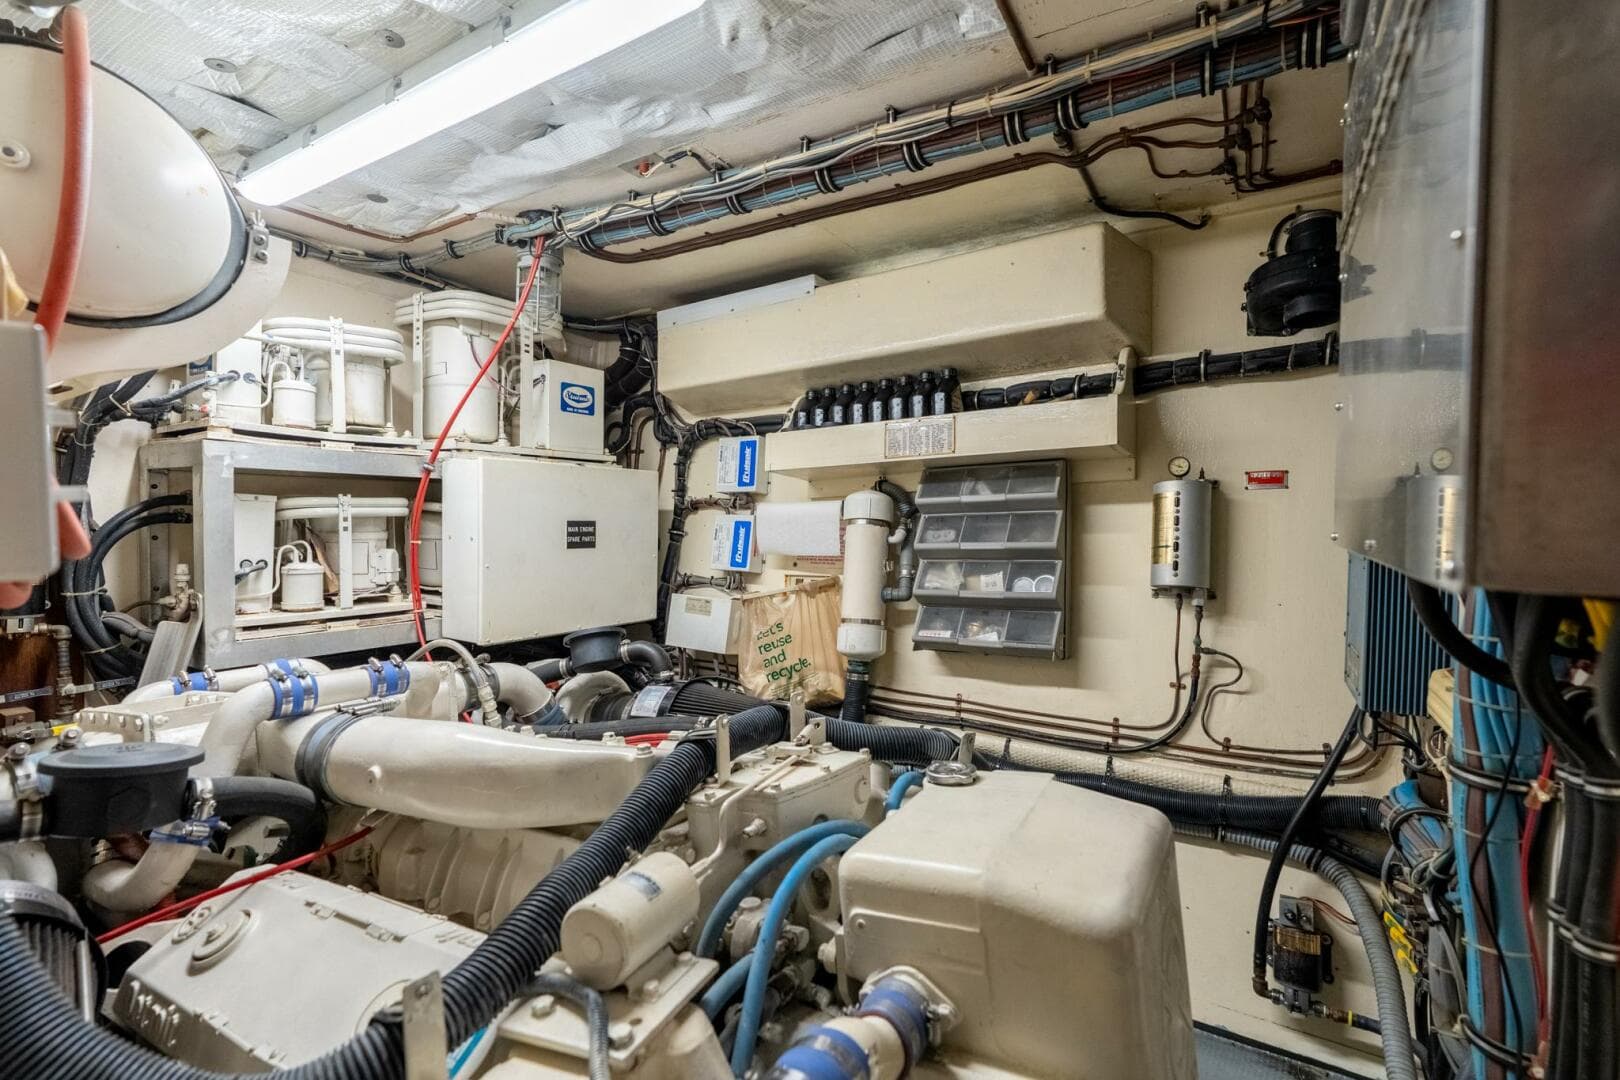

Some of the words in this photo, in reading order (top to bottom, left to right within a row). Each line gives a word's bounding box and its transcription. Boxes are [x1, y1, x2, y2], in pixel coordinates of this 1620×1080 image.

[758, 634, 793, 655] reuse
[763, 649, 787, 668] and
[766, 657, 812, 683] recycle.
